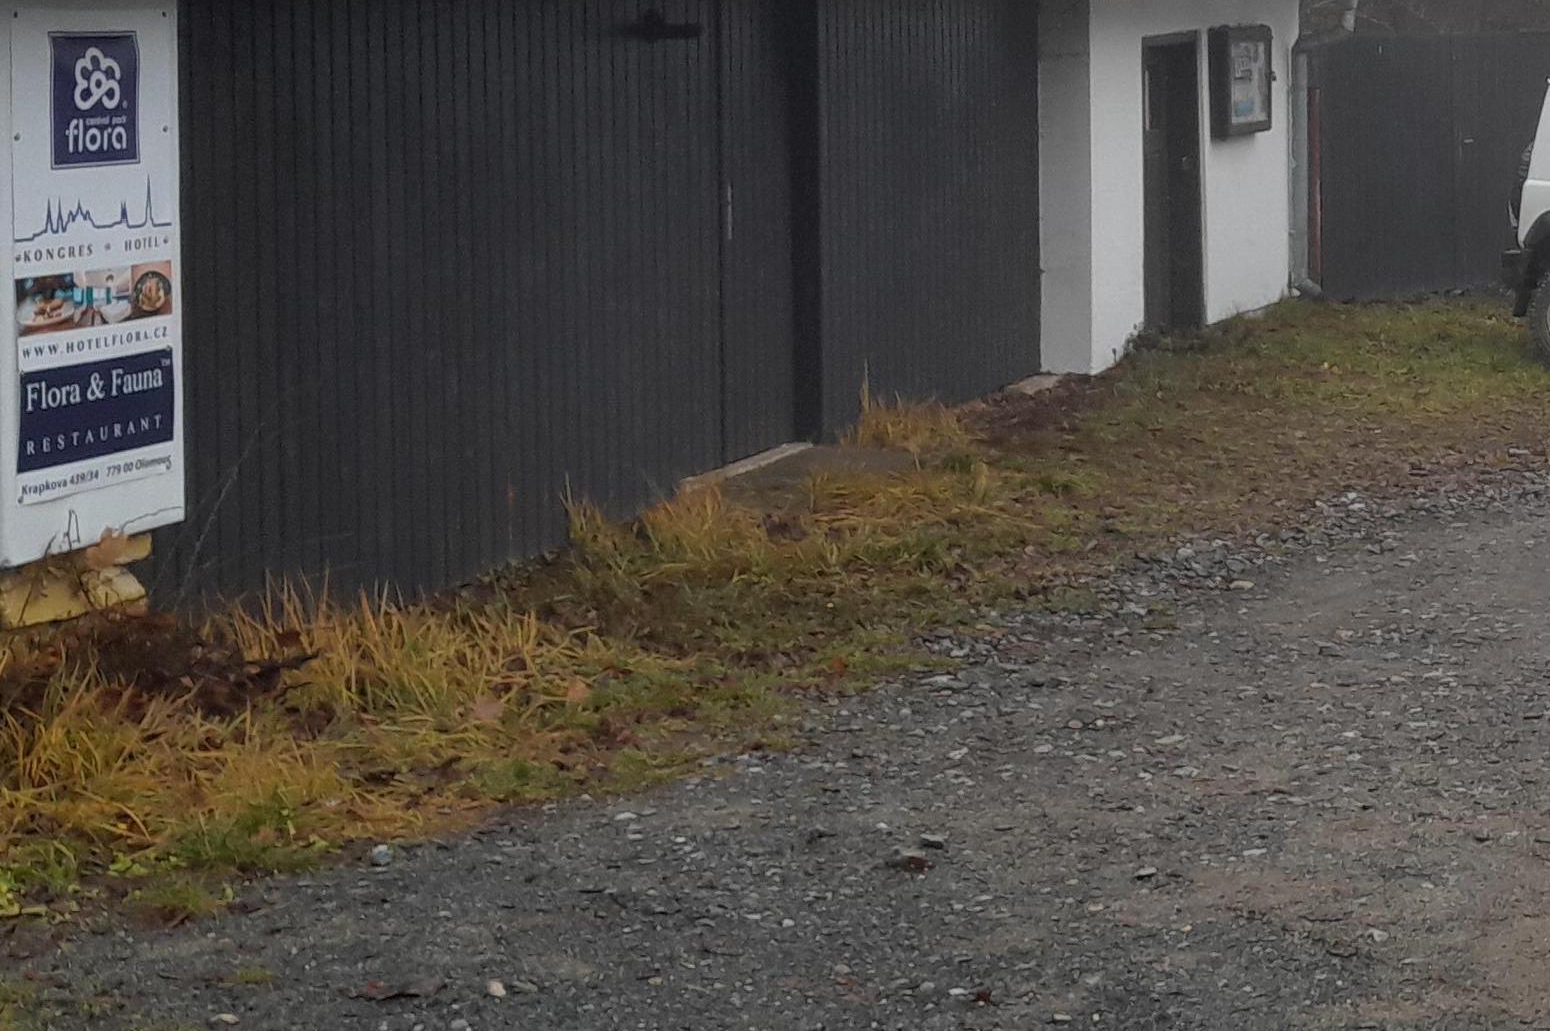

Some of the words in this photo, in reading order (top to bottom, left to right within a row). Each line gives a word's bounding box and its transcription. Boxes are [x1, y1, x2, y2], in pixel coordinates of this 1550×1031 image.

[65, 118, 127, 153] flora
[23, 244, 94, 263] KONGRES
[125, 236, 159, 251] HOTEL
[22, 326, 168, 359] WWW.HOTELFLORA.CZ
[26, 381, 81, 412] Flora
[87, 372, 105, 401] &
[111, 368, 163, 397] Fauna
[26, 414, 162, 455] RESTAURANT
[21, 478, 67, 496] Krapkova
